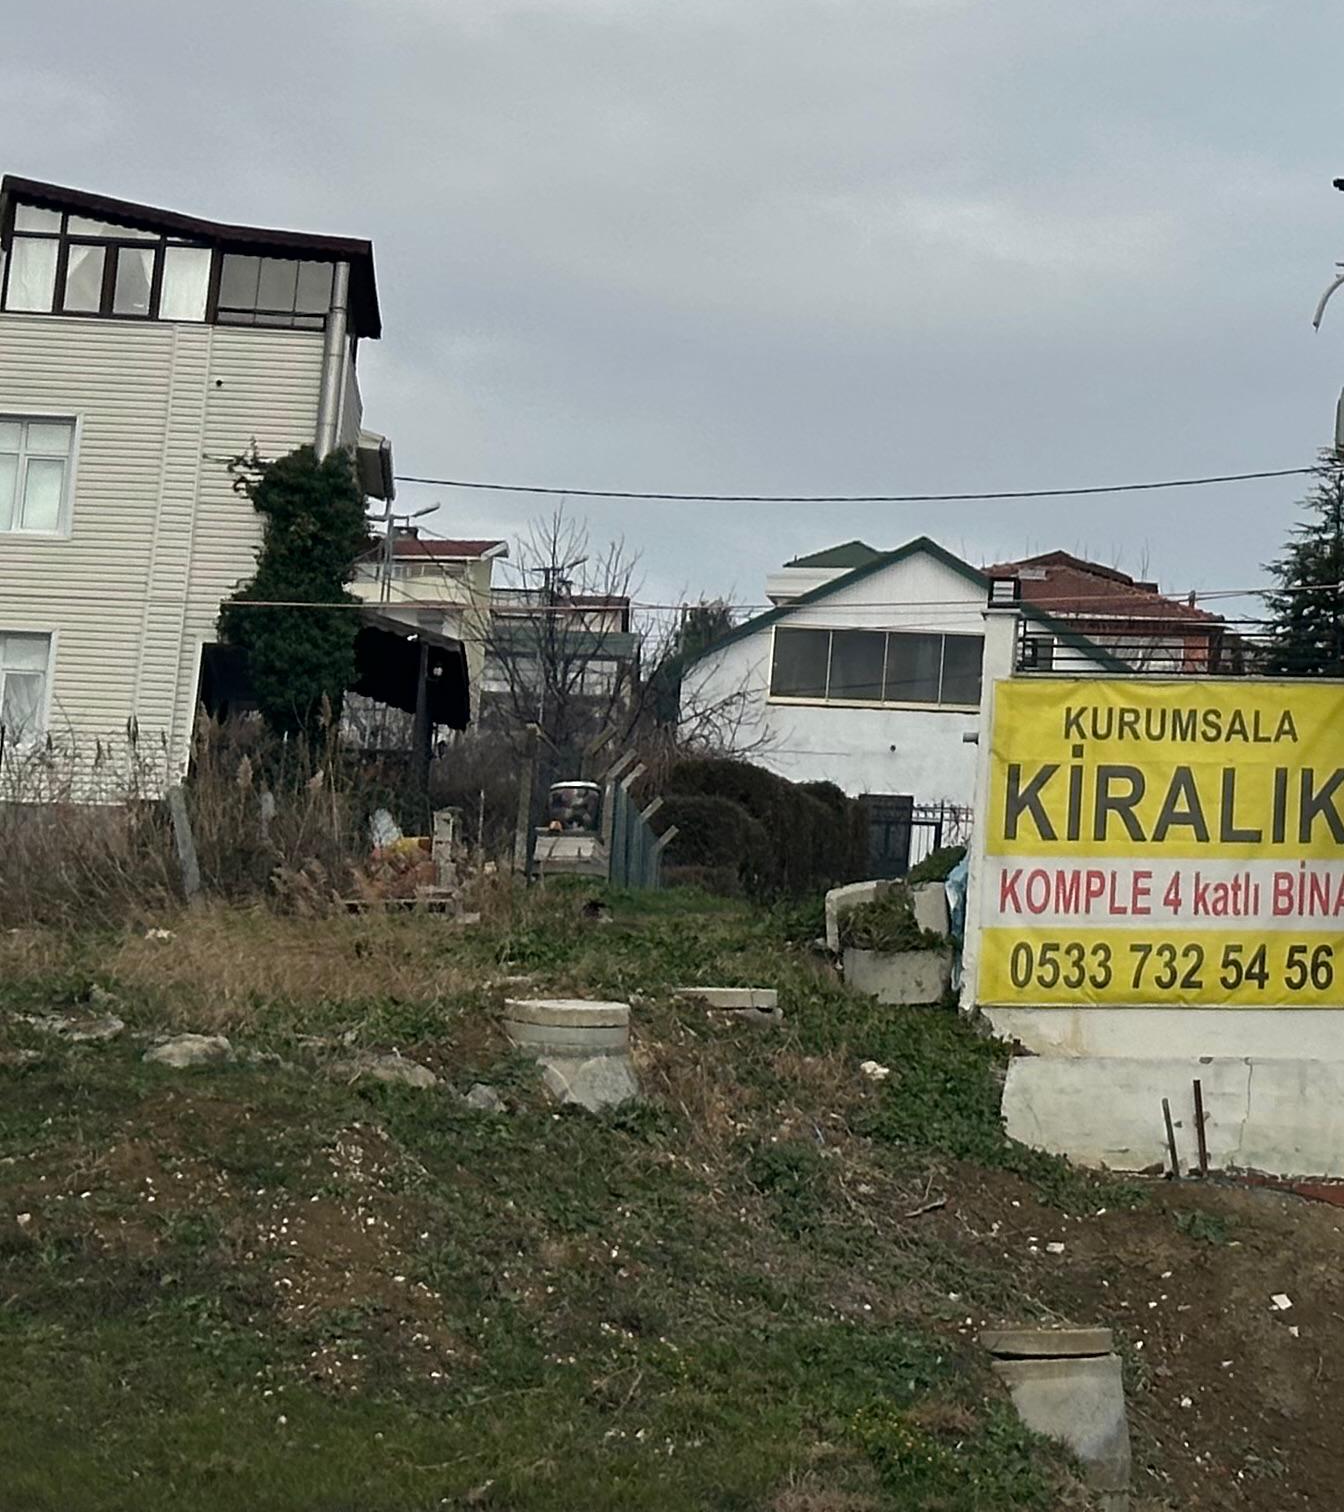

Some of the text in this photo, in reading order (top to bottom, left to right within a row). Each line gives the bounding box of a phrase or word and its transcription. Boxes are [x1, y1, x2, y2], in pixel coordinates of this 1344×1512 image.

[1063, 706, 1299, 743] KURUMSALA
[999, 868, 1153, 916] KOMPLE
[1163, 870, 1182, 916] 4
[1193, 872, 1260, 917] katlı
[1010, 941, 1335, 991] 0533 732 54 56
